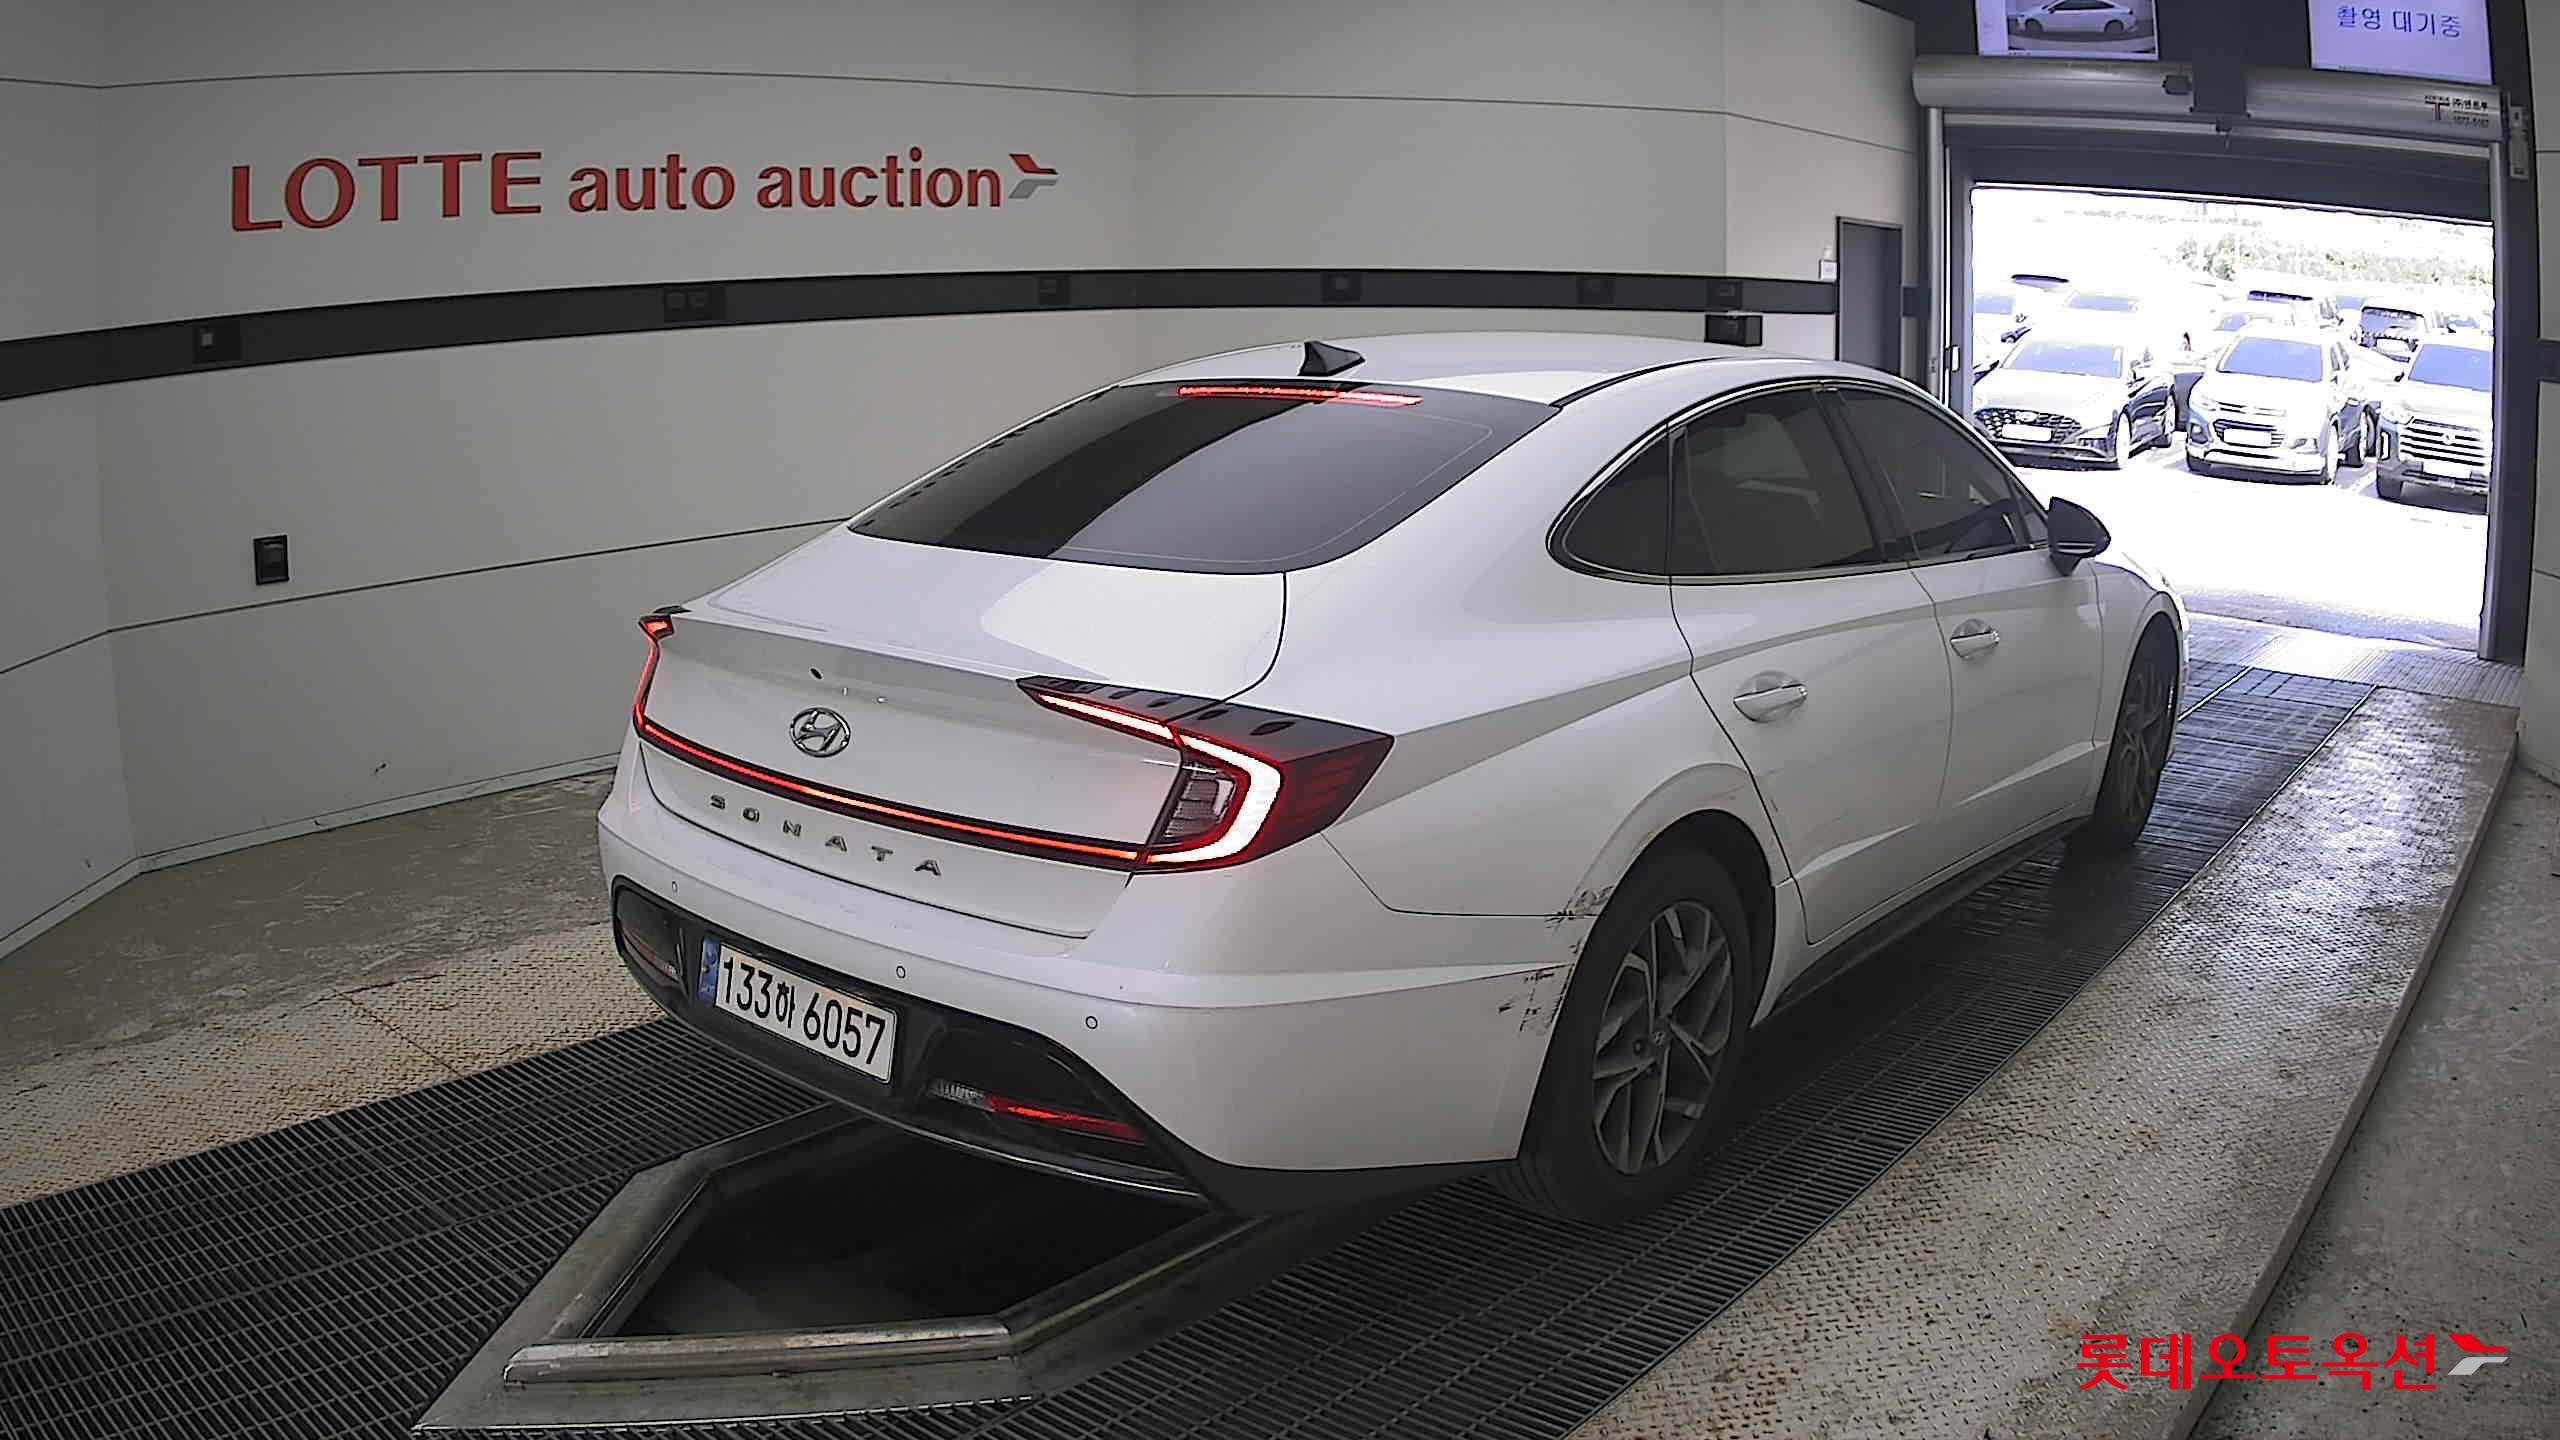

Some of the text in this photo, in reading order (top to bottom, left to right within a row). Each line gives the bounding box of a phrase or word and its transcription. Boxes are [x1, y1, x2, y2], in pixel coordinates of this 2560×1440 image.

[2337, 5, 2461, 39] 촬영 대기중
[231, 147, 1003, 231] LOTTE auto auction
[709, 794, 942, 877] SONATA
[803, 991, 886, 1065] 6057
